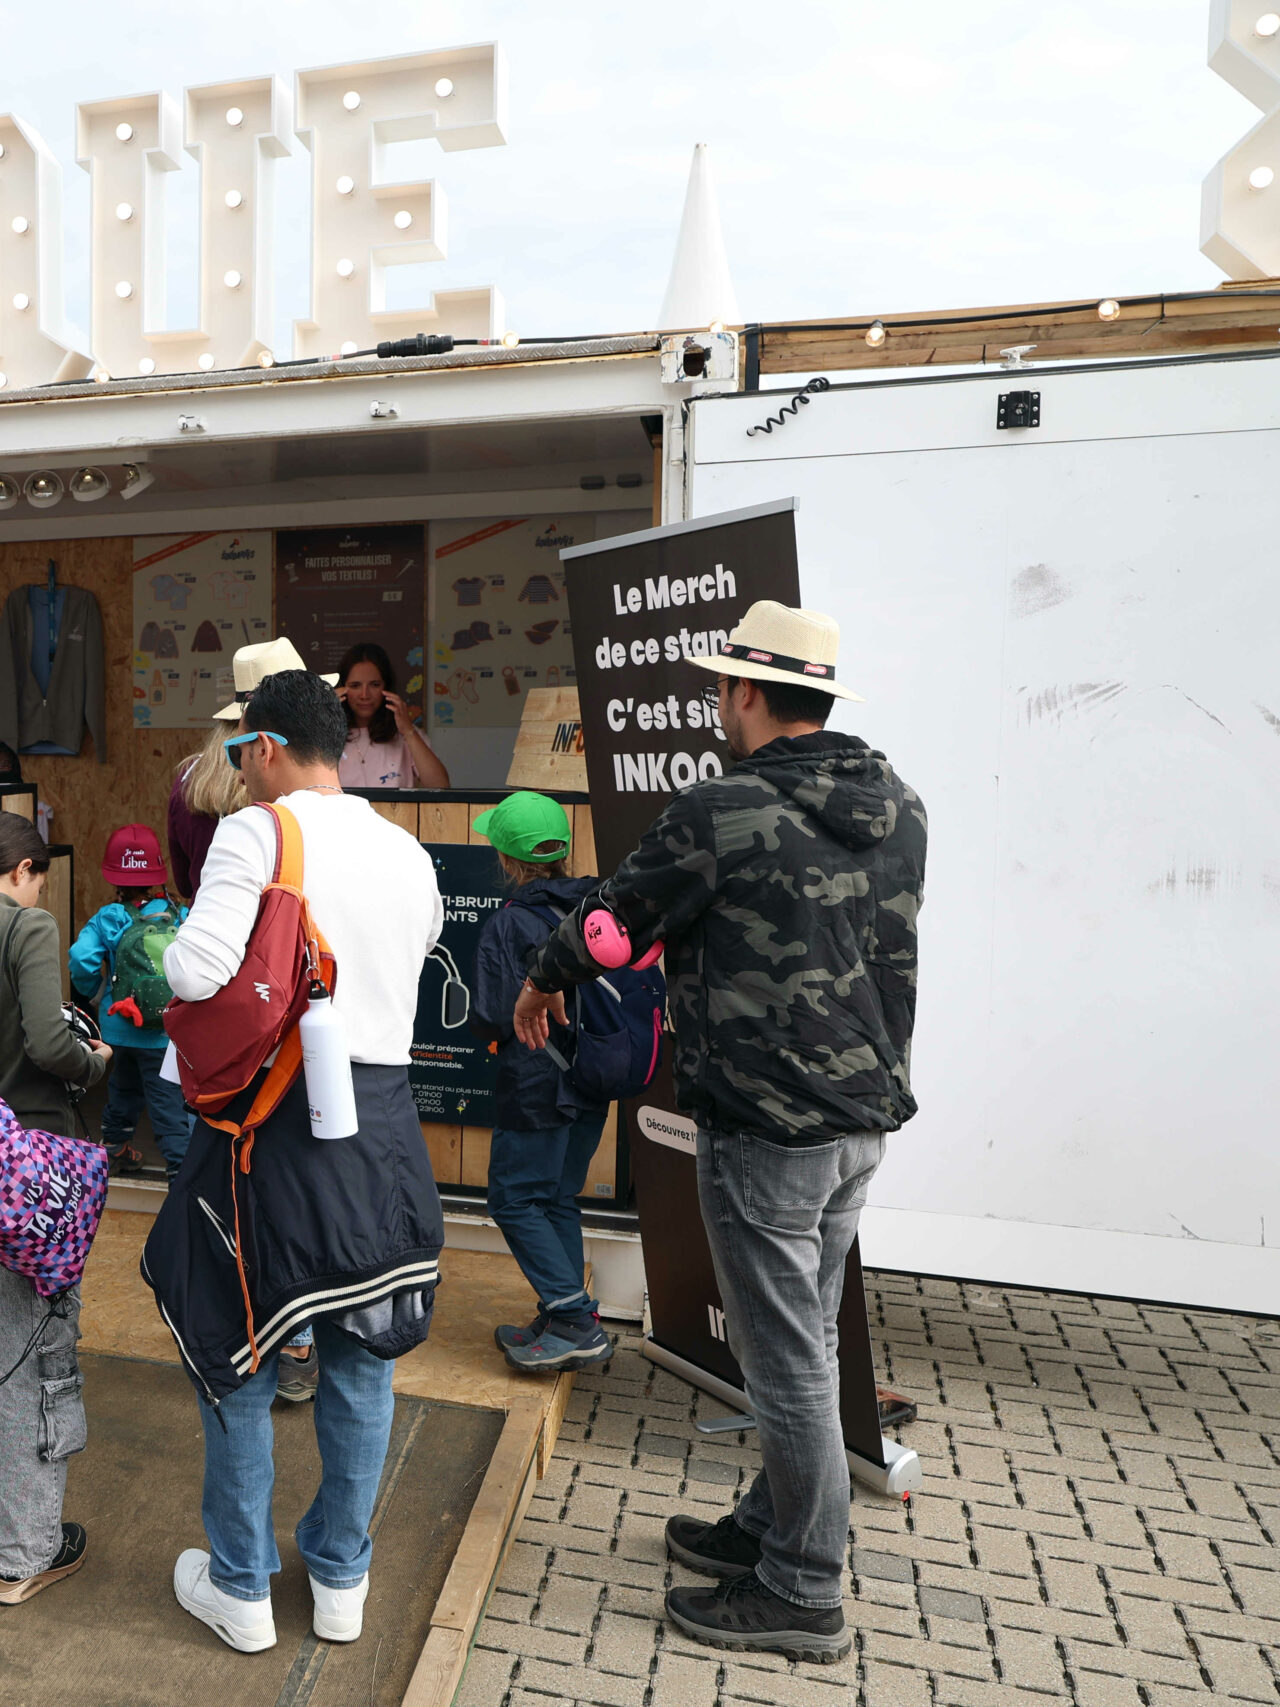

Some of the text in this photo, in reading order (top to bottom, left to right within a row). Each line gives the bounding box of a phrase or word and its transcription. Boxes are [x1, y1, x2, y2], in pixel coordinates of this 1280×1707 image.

[305, 554, 392, 569] FAITES PERSONNALISER
[321, 570, 337, 582] VOS
[338, 569, 373, 581] TEXTILES
[613, 563, 737, 616] Le Merch
[312, 613, 318, 623] 1
[311, 641, 320, 651] 2
[595, 636, 626, 669] de
[630, 638, 659, 666] ce
[607, 694, 681, 732] C'est
[122, 856, 148, 868] Libre
[443, 910, 478, 923] NTS
[588, 926, 602, 940] kid
[412, 1050, 454, 1060] d'identité
[437, 1045, 476, 1054] préparer
[412, 1059, 464, 1069] esponsable.
[418, 1090, 442, 1098] 01h00
[456, 1087, 472, 1095] plus
[415, 1097, 441, 1106] 00h00
[419, 1105, 445, 1113] 23h00
[646, 1116, 690, 1142] Découvrez
[23, 1180, 44, 1205] VIS
[68, 1178, 82, 1210] BIEN
[23, 1164, 70, 1239] TA VIE
